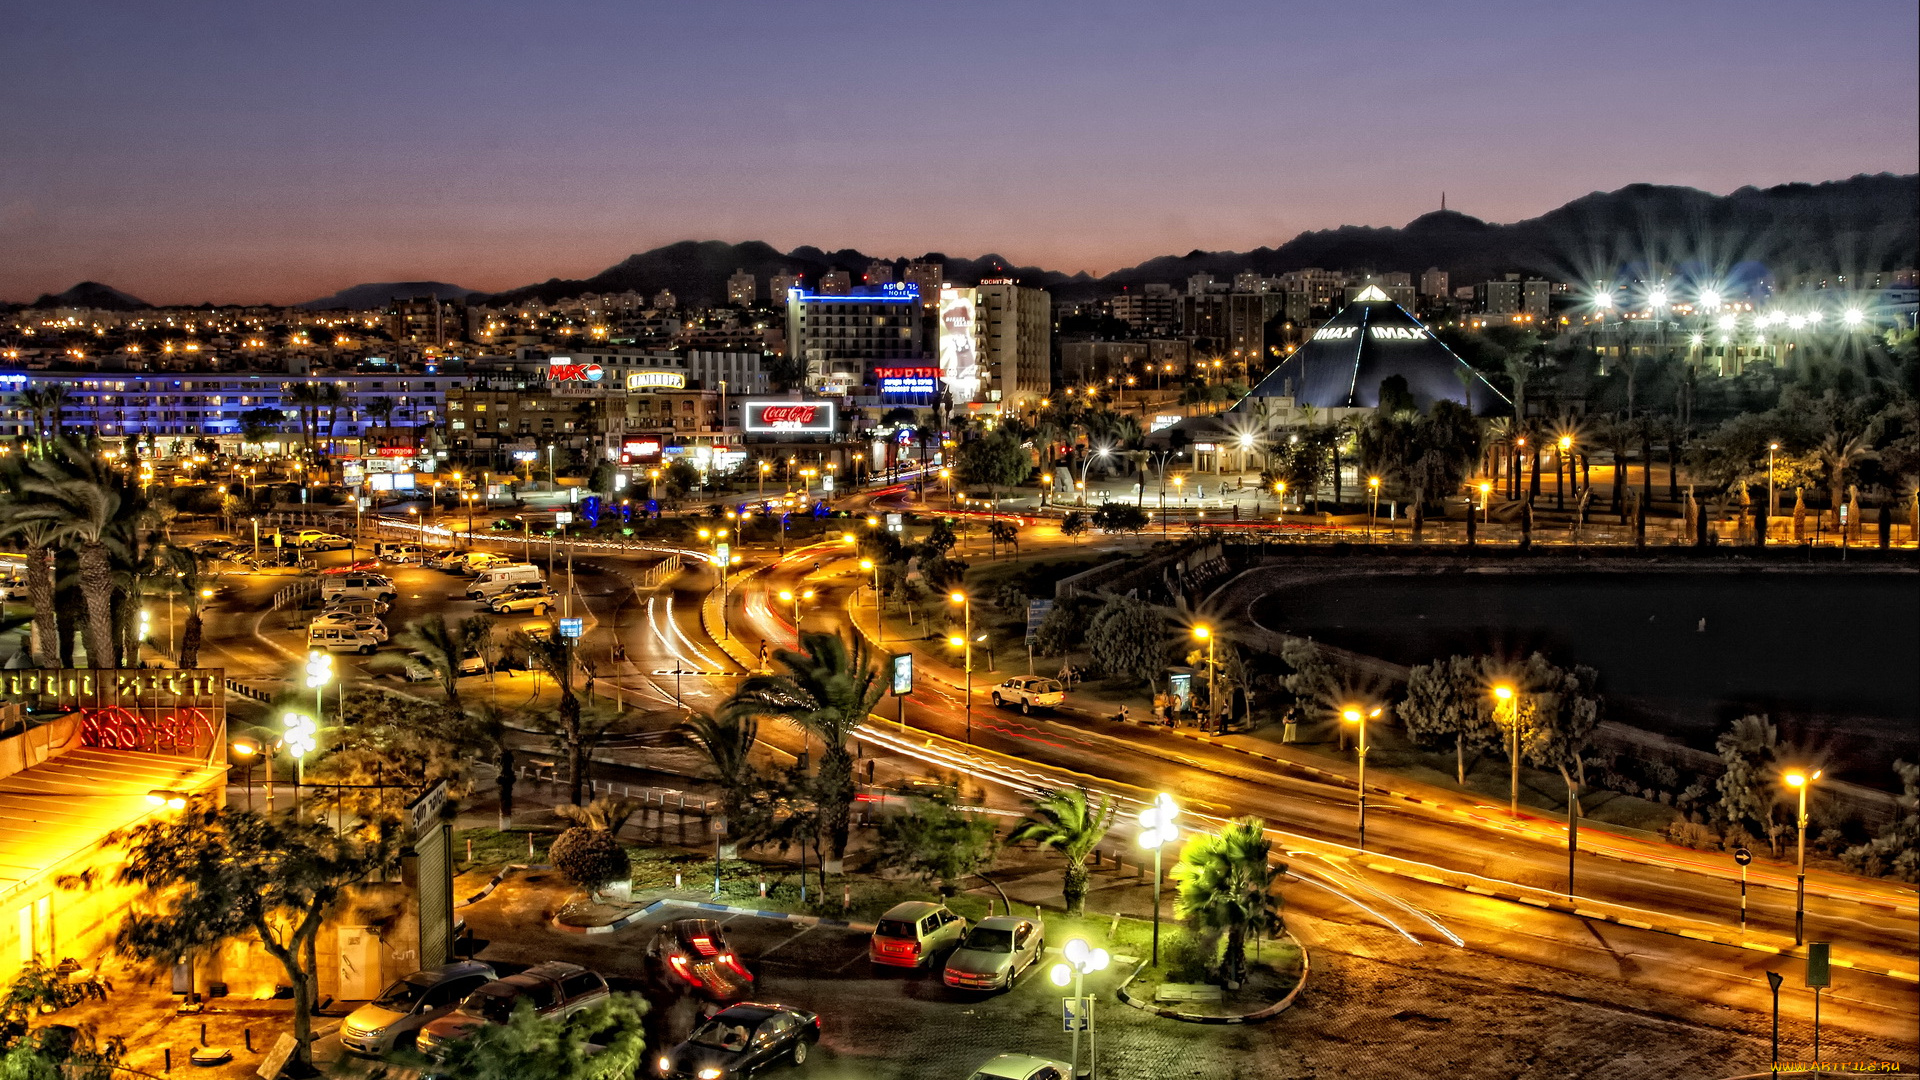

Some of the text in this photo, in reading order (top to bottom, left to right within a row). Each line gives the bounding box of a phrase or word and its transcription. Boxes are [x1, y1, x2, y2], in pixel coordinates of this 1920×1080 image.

[1313, 326, 1359, 340] IMAX
[1370, 326, 1428, 340] IMAX
[547, 364, 590, 382] MAX
